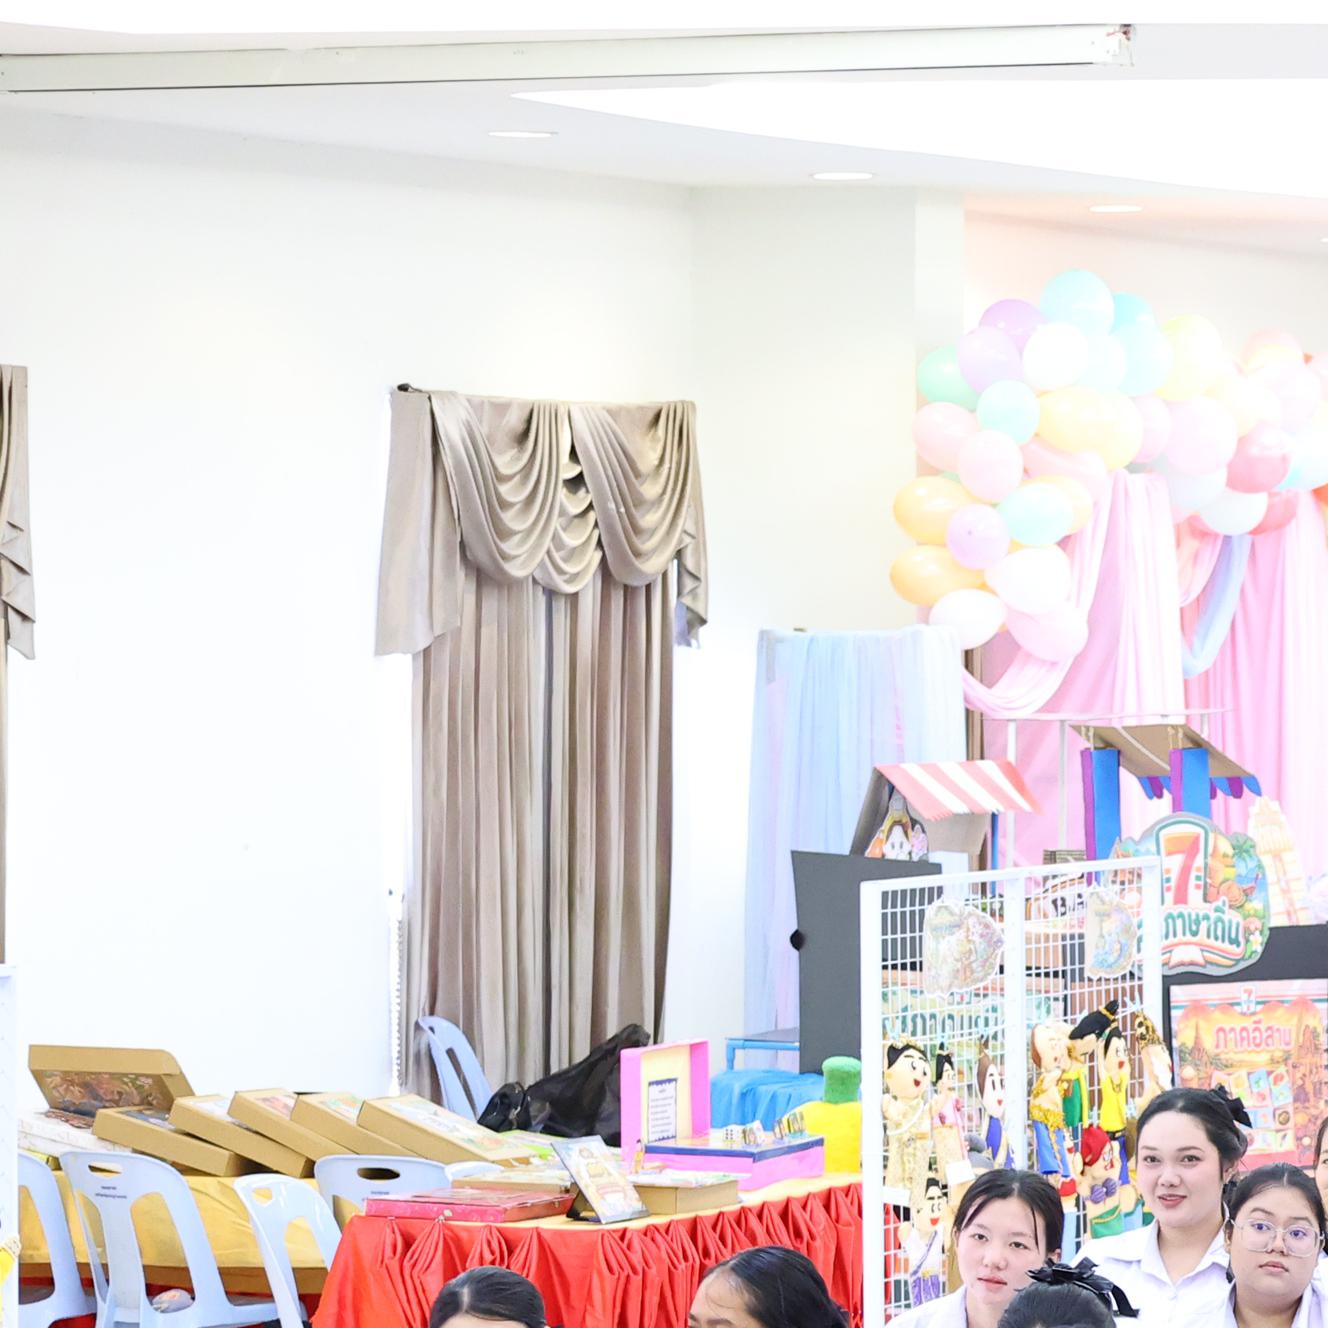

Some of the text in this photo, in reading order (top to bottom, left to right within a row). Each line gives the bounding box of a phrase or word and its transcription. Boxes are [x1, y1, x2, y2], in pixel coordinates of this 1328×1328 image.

[1163, 832, 1201, 905] 7
[1137, 899, 1242, 953] ภาษาถิ่น
[1215, 1019, 1292, 1050] ภาคอีสาน
